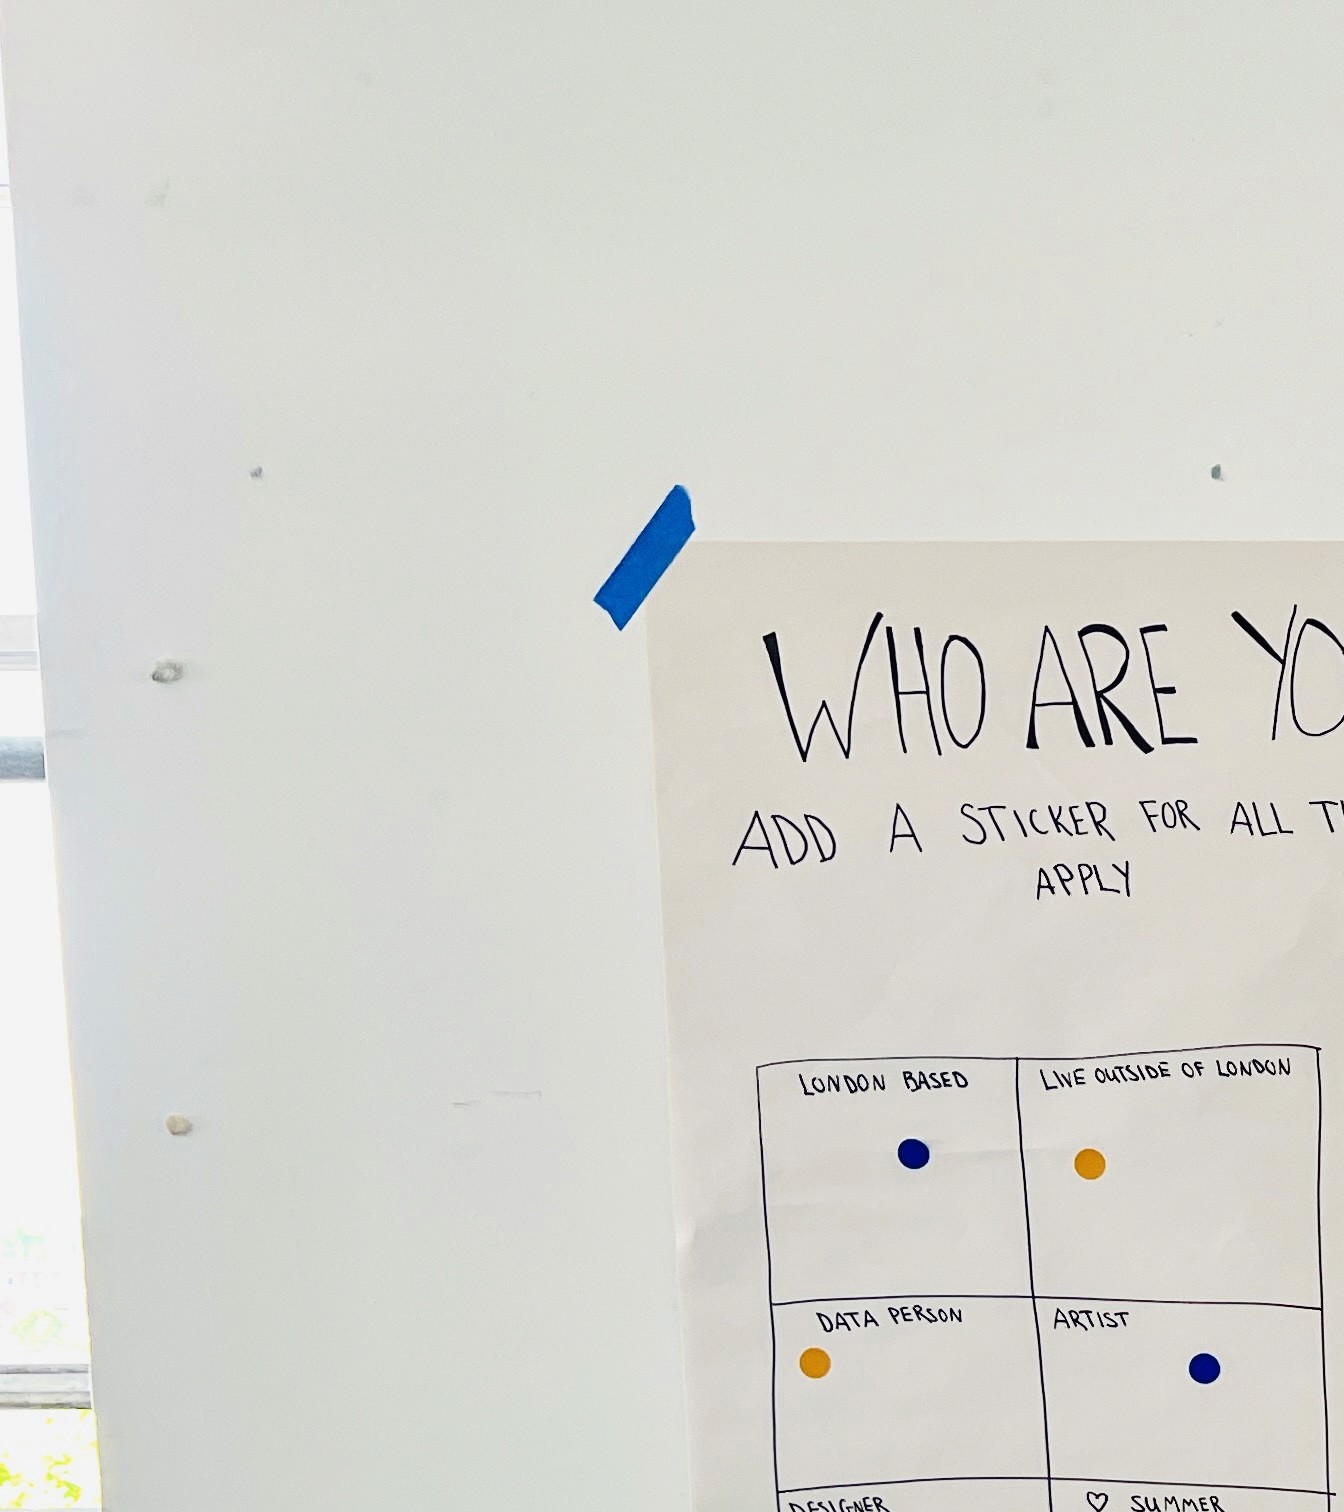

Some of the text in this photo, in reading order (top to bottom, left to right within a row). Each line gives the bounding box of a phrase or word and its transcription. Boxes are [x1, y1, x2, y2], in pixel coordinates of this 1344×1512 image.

[761, 611, 987, 763] WHO
[1025, 623, 1199, 755] ARE
[731, 809, 837, 870] ADD
[889, 802, 923, 854] A
[960, 800, 1116, 846] STICKER
[1138, 799, 1201, 833] FOR
[1229, 800, 1295, 837] ALL
[1036, 860, 1131, 901] APPLY
[797, 1070, 969, 1097] LONDON BASED
[1039, 1057, 1292, 1092] LIVE OUTSIDE OF LONDON
[815, 1304, 963, 1334] DATA PERSON
[1053, 1307, 1130, 1332] ARTIST
